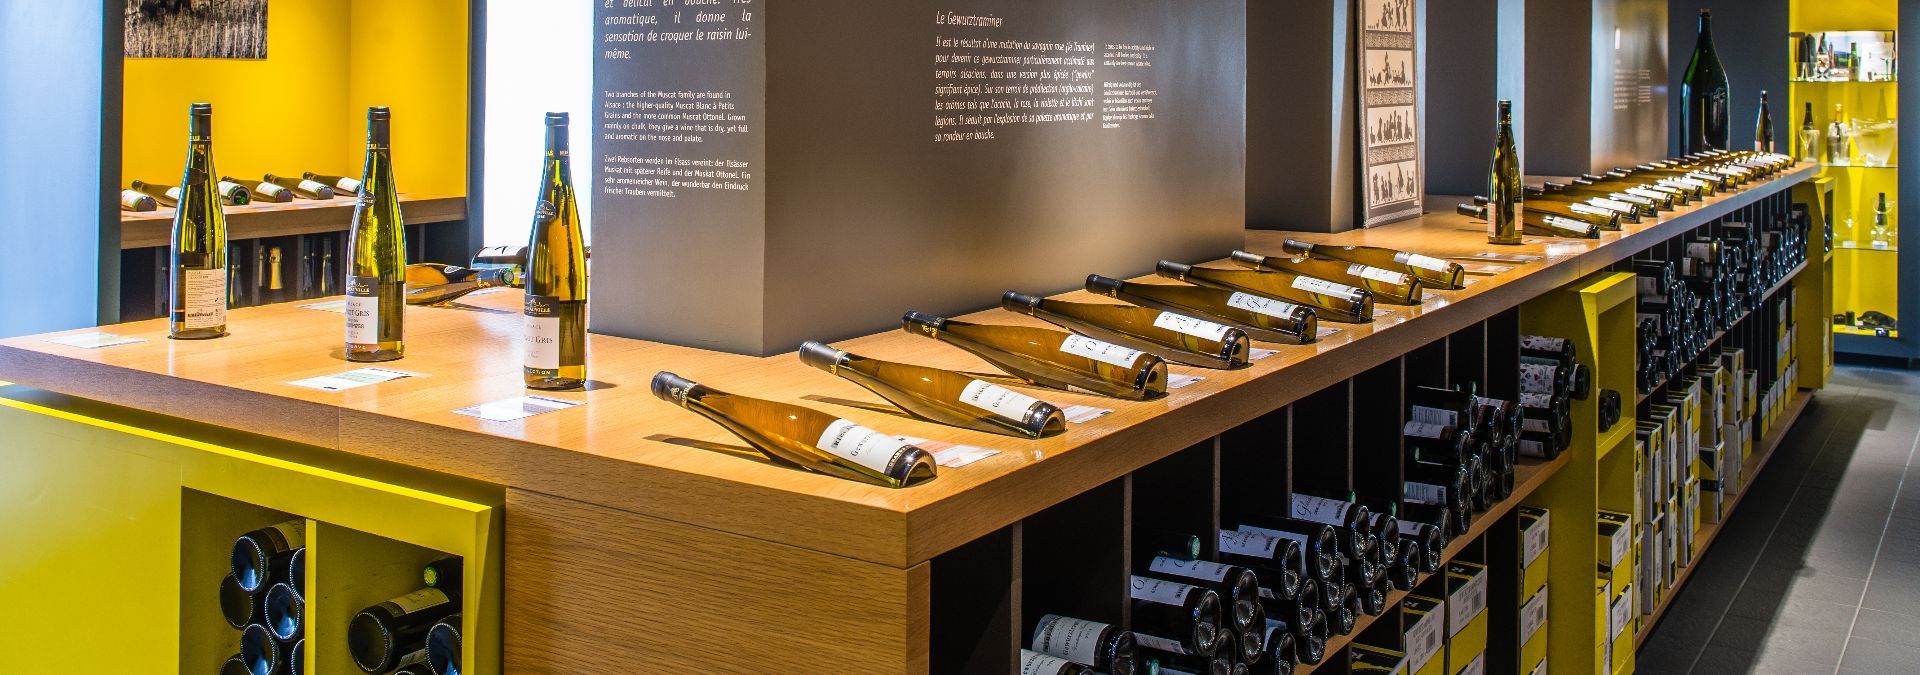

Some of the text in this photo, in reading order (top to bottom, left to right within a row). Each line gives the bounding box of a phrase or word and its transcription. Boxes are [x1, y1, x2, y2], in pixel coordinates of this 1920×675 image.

[604, 0, 614, 8] et
[604, 9, 752, 25] aromatique, il donne la
[936, 11, 1003, 27] Le Gewurztraminer
[604, 28, 752, 43] sensation de croquer le raisin lui-
[604, 48, 632, 59] même.
[678, 91, 695, 100] family
[636, 101, 673, 110] higher-quality
[649, 123, 660, 131] they
[662, 123, 673, 132] give
[715, 124, 725, 133] dry,
[934, 129, 994, 142] sa rondeur en bouche.
[618, 156, 643, 164] Rebsorten
[727, 160, 748, 168] Elsässer
[604, 186, 623, 194] frischer
[655, 179, 669, 187] Wein,
[682, 180, 711, 189] wunderbar
[712, 180, 722, 189] den
[725, 182, 748, 190] Eindruck
